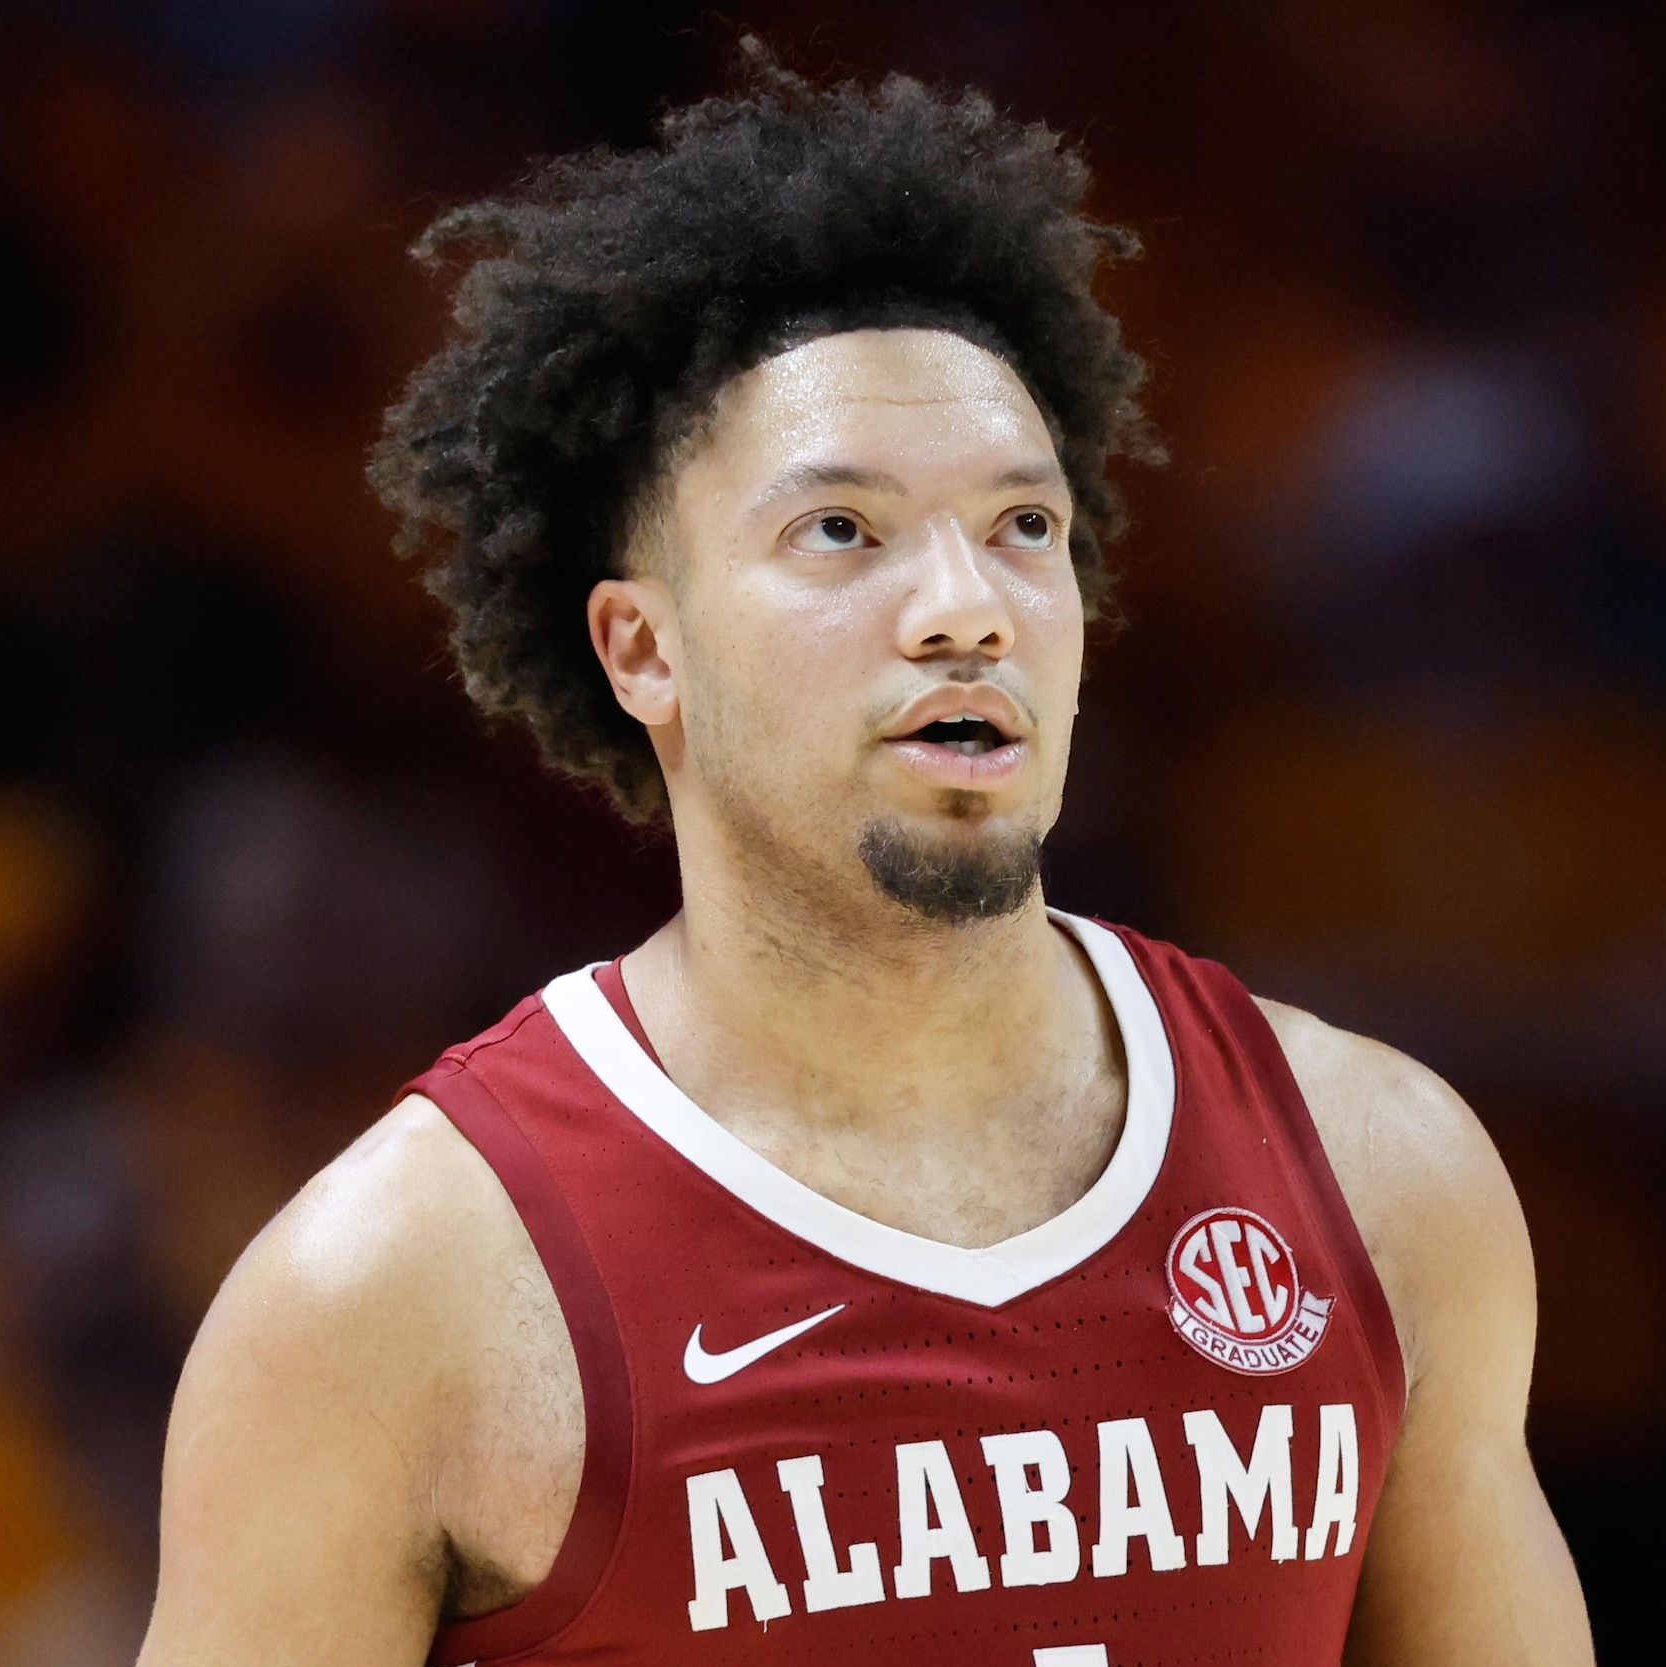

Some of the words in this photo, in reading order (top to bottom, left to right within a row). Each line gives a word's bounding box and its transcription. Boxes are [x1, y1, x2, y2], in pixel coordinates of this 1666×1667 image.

[1179, 1219, 1289, 1334] SEC
[1191, 1320, 1319, 1369] GRADUATE
[686, 1403, 1359, 1632] ALABAMA
